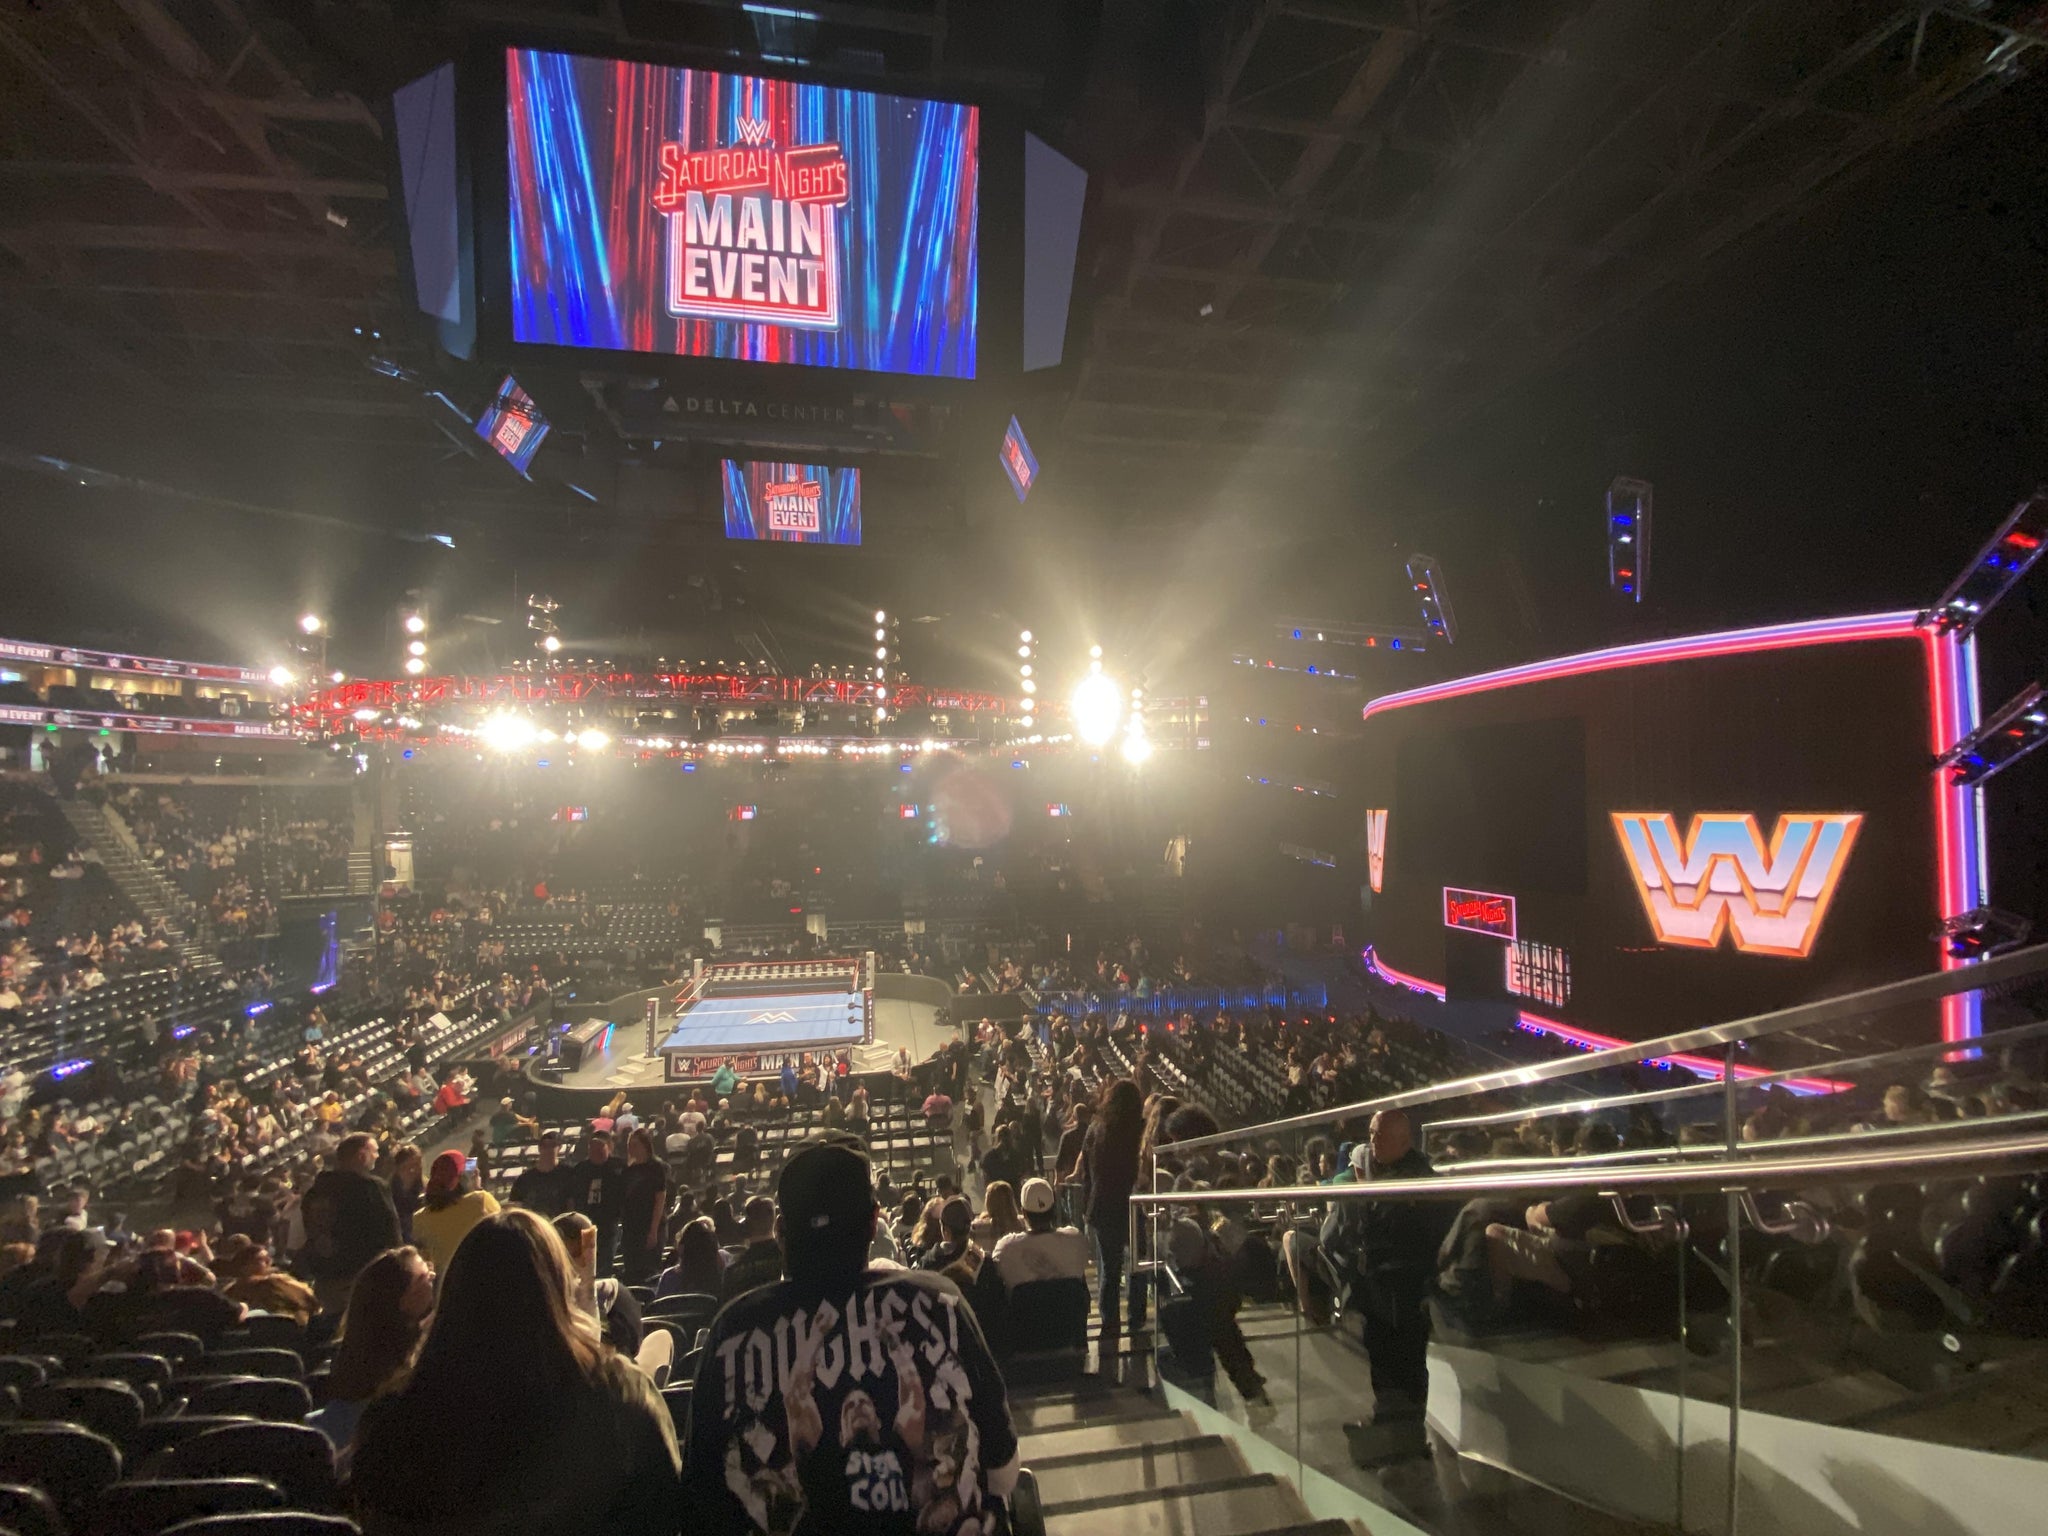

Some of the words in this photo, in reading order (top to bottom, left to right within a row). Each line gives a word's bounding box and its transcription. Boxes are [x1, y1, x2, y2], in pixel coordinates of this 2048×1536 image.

[655, 145, 770, 205] SATURDAY
[686, 190, 822, 255] MAIN
[685, 247, 824, 307] EVENT
[686, 396, 758, 417] DELTA
[766, 402, 846, 424] CENTER
[773, 495, 814, 513] MAIN
[773, 511, 814, 526] EVENT
[17, 645, 52, 658] EVENT
[9, 709, 44, 721] EVENT
[234, 724, 260, 736] MAIN
[1511, 940, 1563, 976] MAIN
[717, 1289, 959, 1419] TOUGHEST
